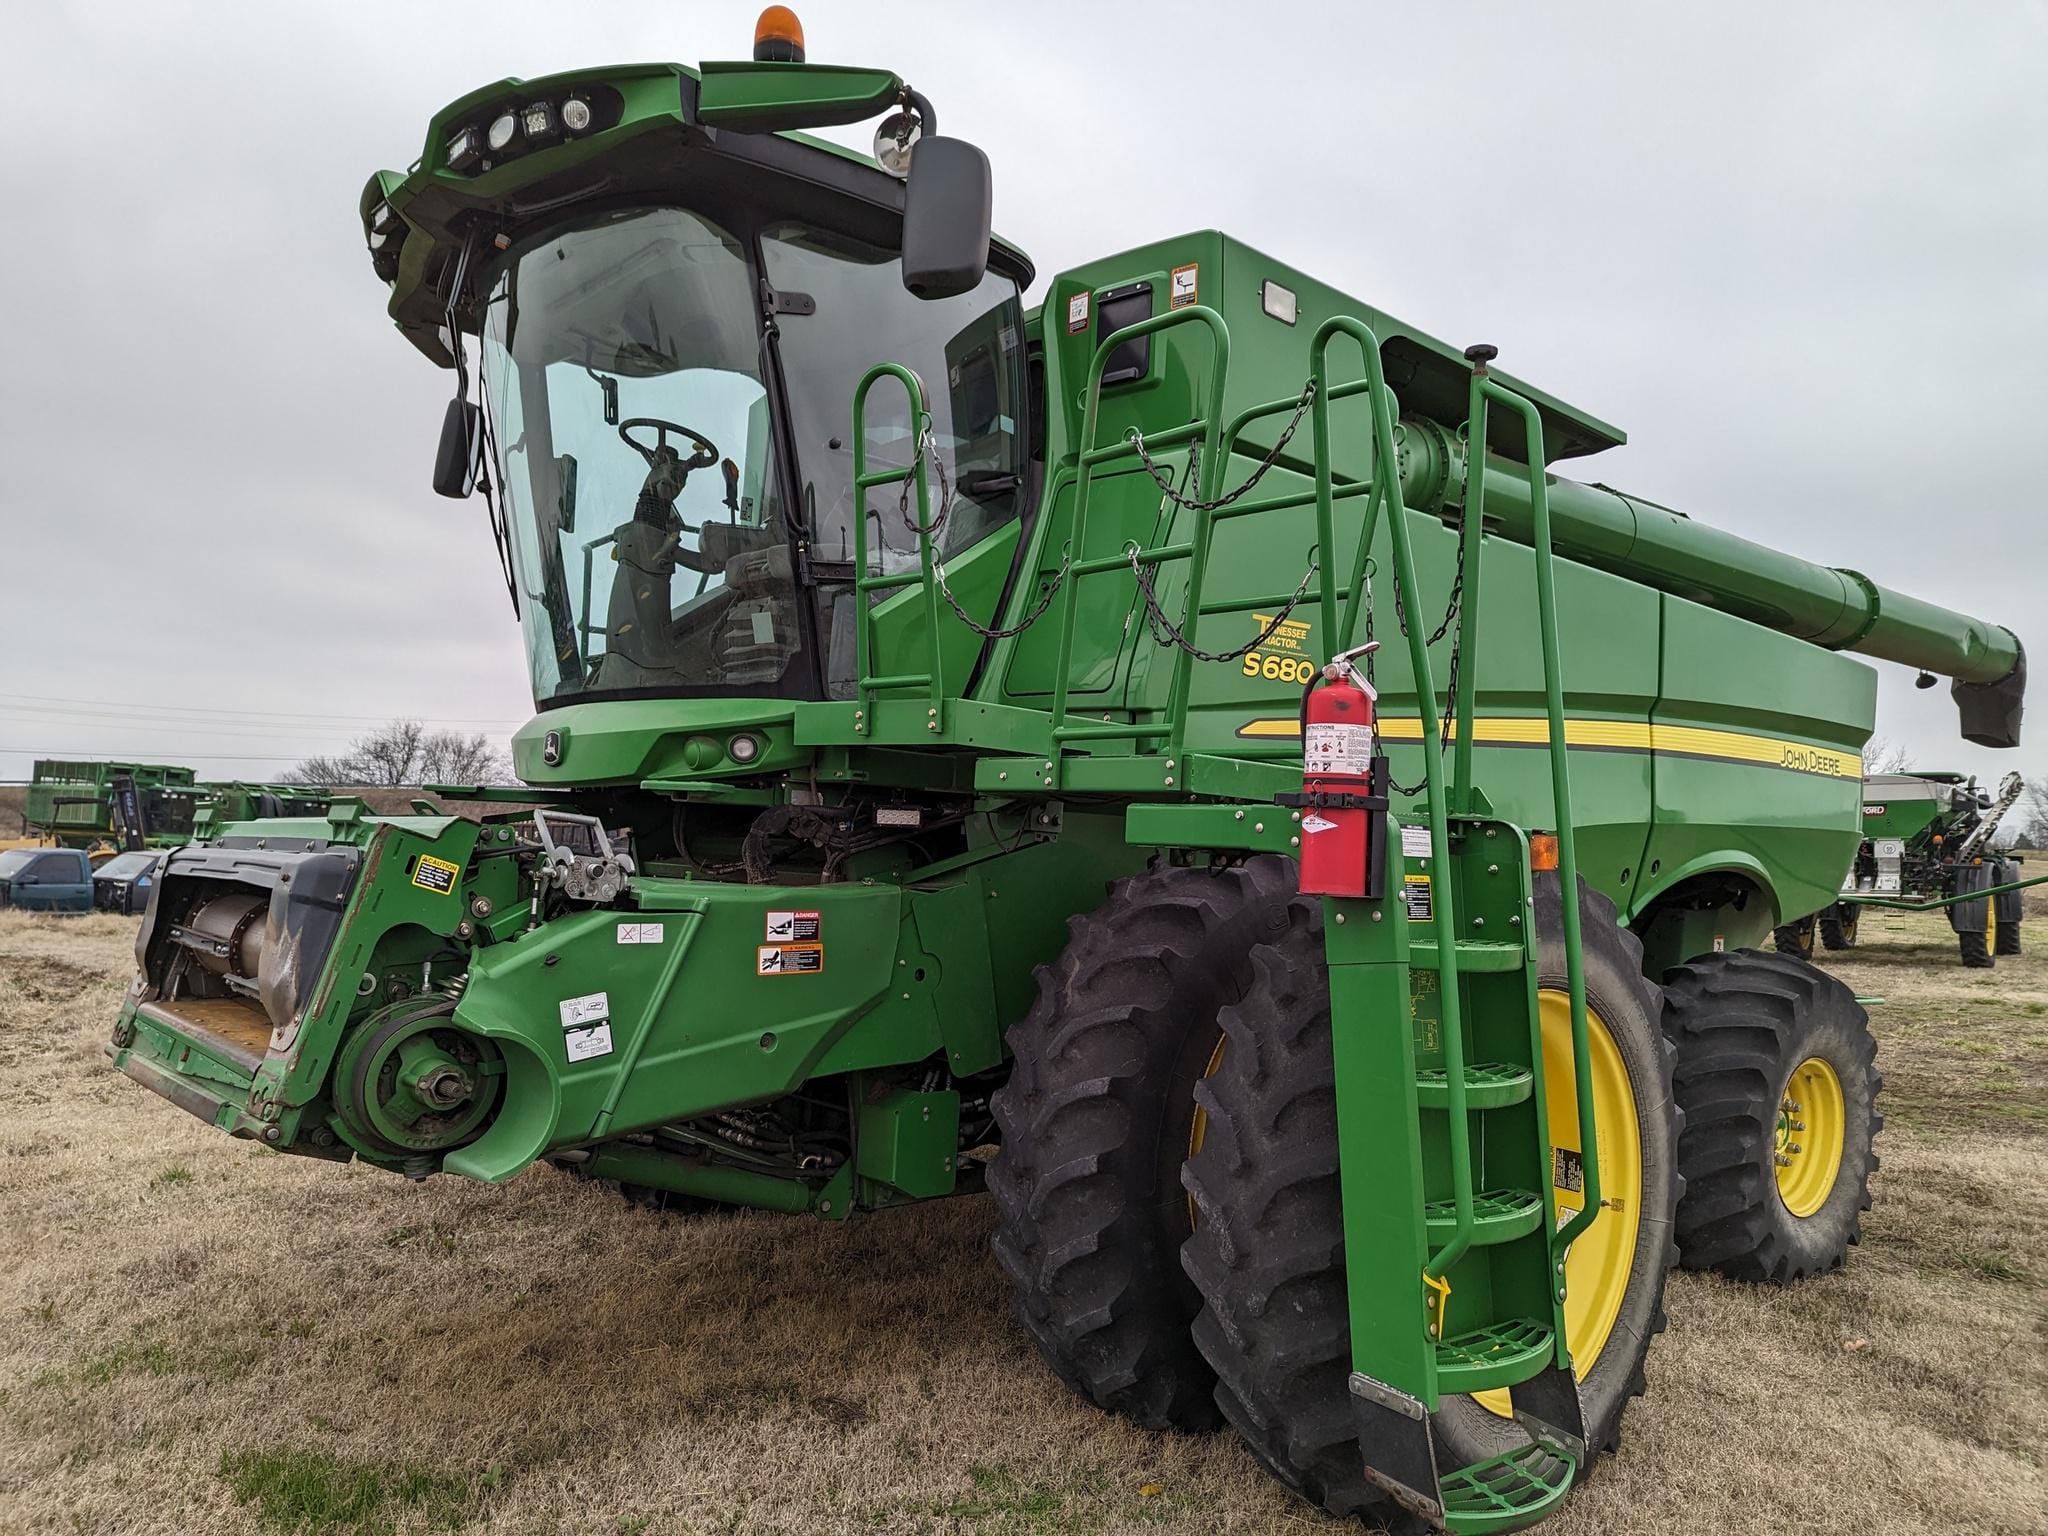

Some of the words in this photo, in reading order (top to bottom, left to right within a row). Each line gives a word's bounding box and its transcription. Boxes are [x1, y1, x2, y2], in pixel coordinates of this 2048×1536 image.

[1242, 652, 1315, 685] S680
[1780, 745, 1808, 767] JOHN
[1809, 750, 1840, 774] DEERE
[428, 858, 458, 872] CAUTION
